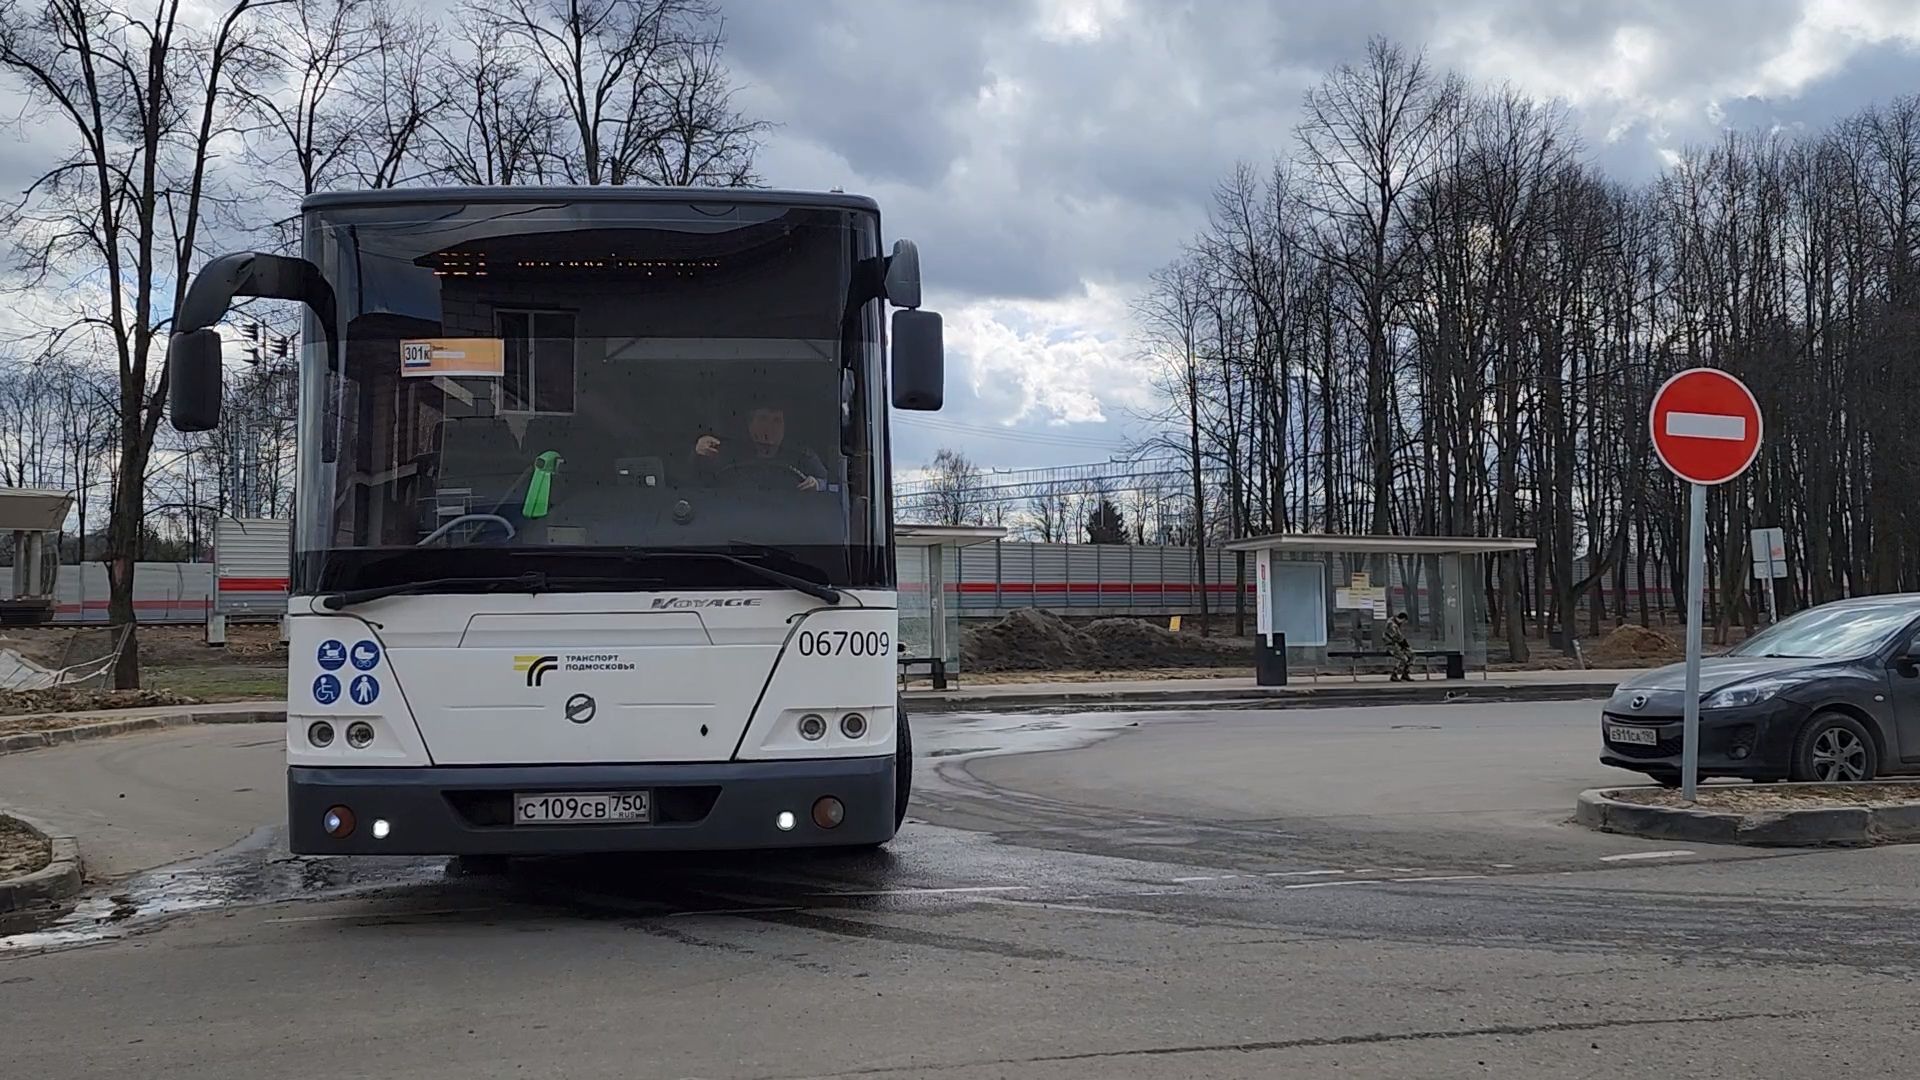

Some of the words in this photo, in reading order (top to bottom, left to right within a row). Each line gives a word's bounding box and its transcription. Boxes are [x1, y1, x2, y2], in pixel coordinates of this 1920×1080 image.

[651, 597, 762, 609] VOYAGE
[799, 631, 889, 656] 067009
[565, 663, 635, 671] ПОДМОСКОВЬЯ
[611, 795, 643, 811] 750
